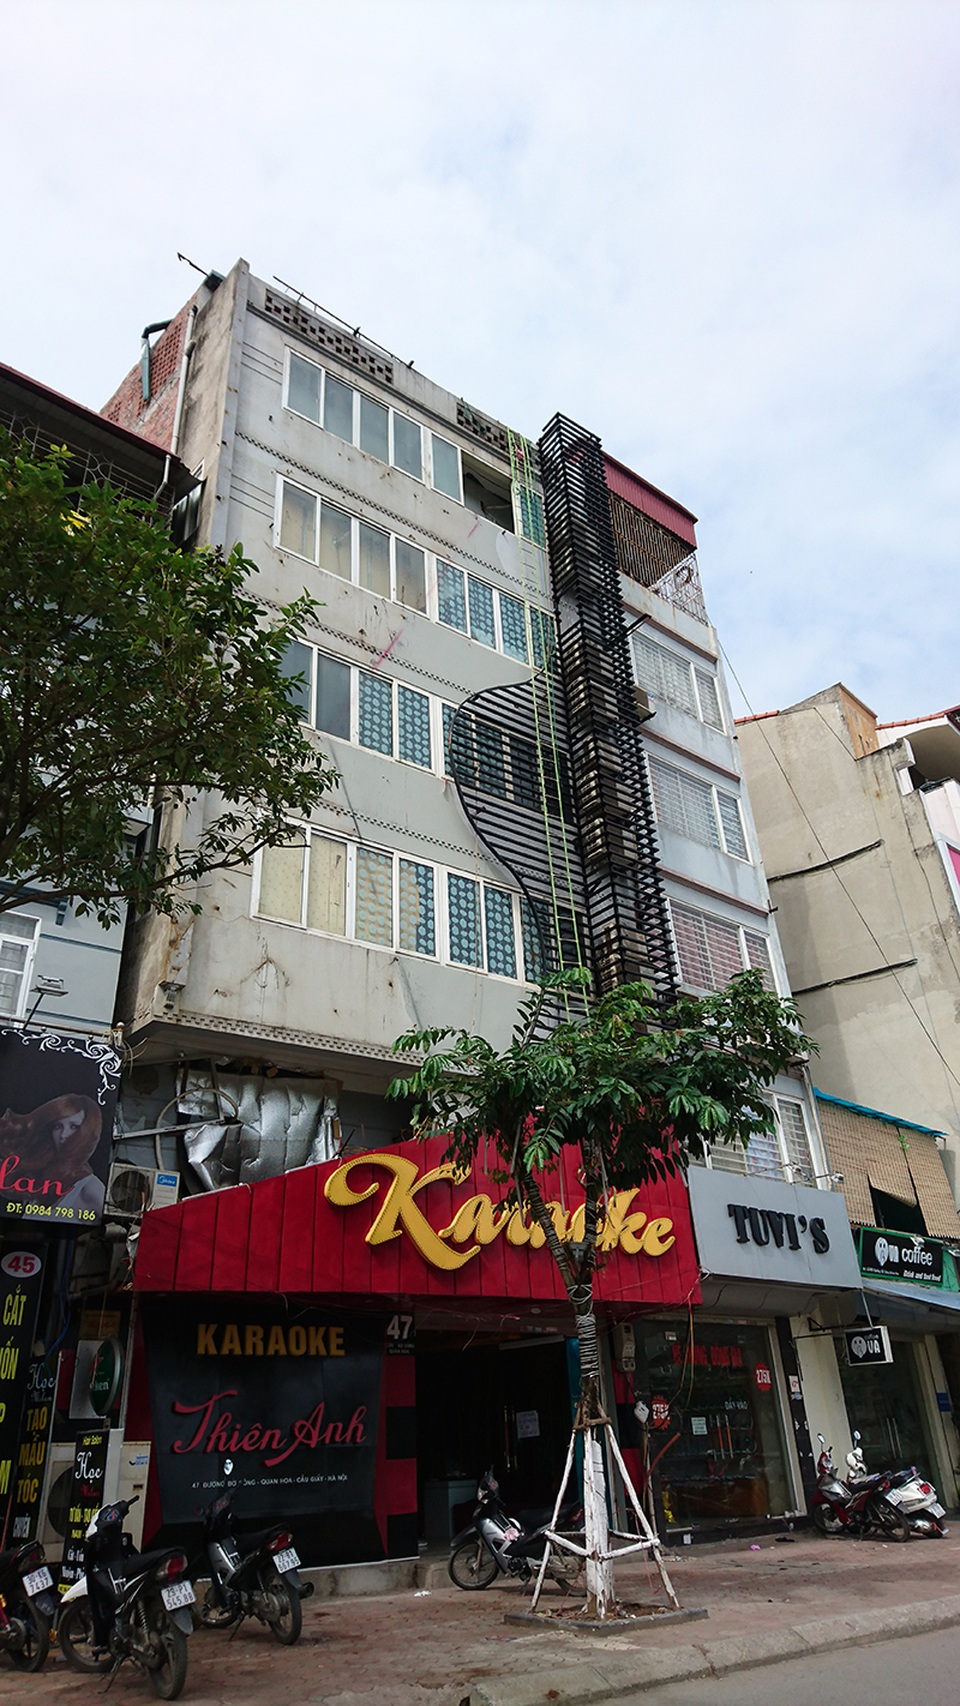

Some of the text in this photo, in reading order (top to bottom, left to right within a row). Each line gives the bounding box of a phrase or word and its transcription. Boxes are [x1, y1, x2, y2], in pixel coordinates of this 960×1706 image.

[25, 1204, 51, 1216] 0984
[54, 1207, 74, 1218] 798
[78, 1208, 96, 1220] 186
[7, 1256, 35, 1274] 45
[901, 1247, 933, 1266] coffee
[2, 1284, 28, 1326] CẮT
[197, 1324, 346, 1357] KARAOKE
[386, 1314, 413, 1340] 47
[0, 1335, 20, 1380] ỐN
[26, 1406, 48, 1434] TẠO
[173, 1389, 367, 1467] Thiên Anh
[16, 1473, 39, 1504] TÓC
